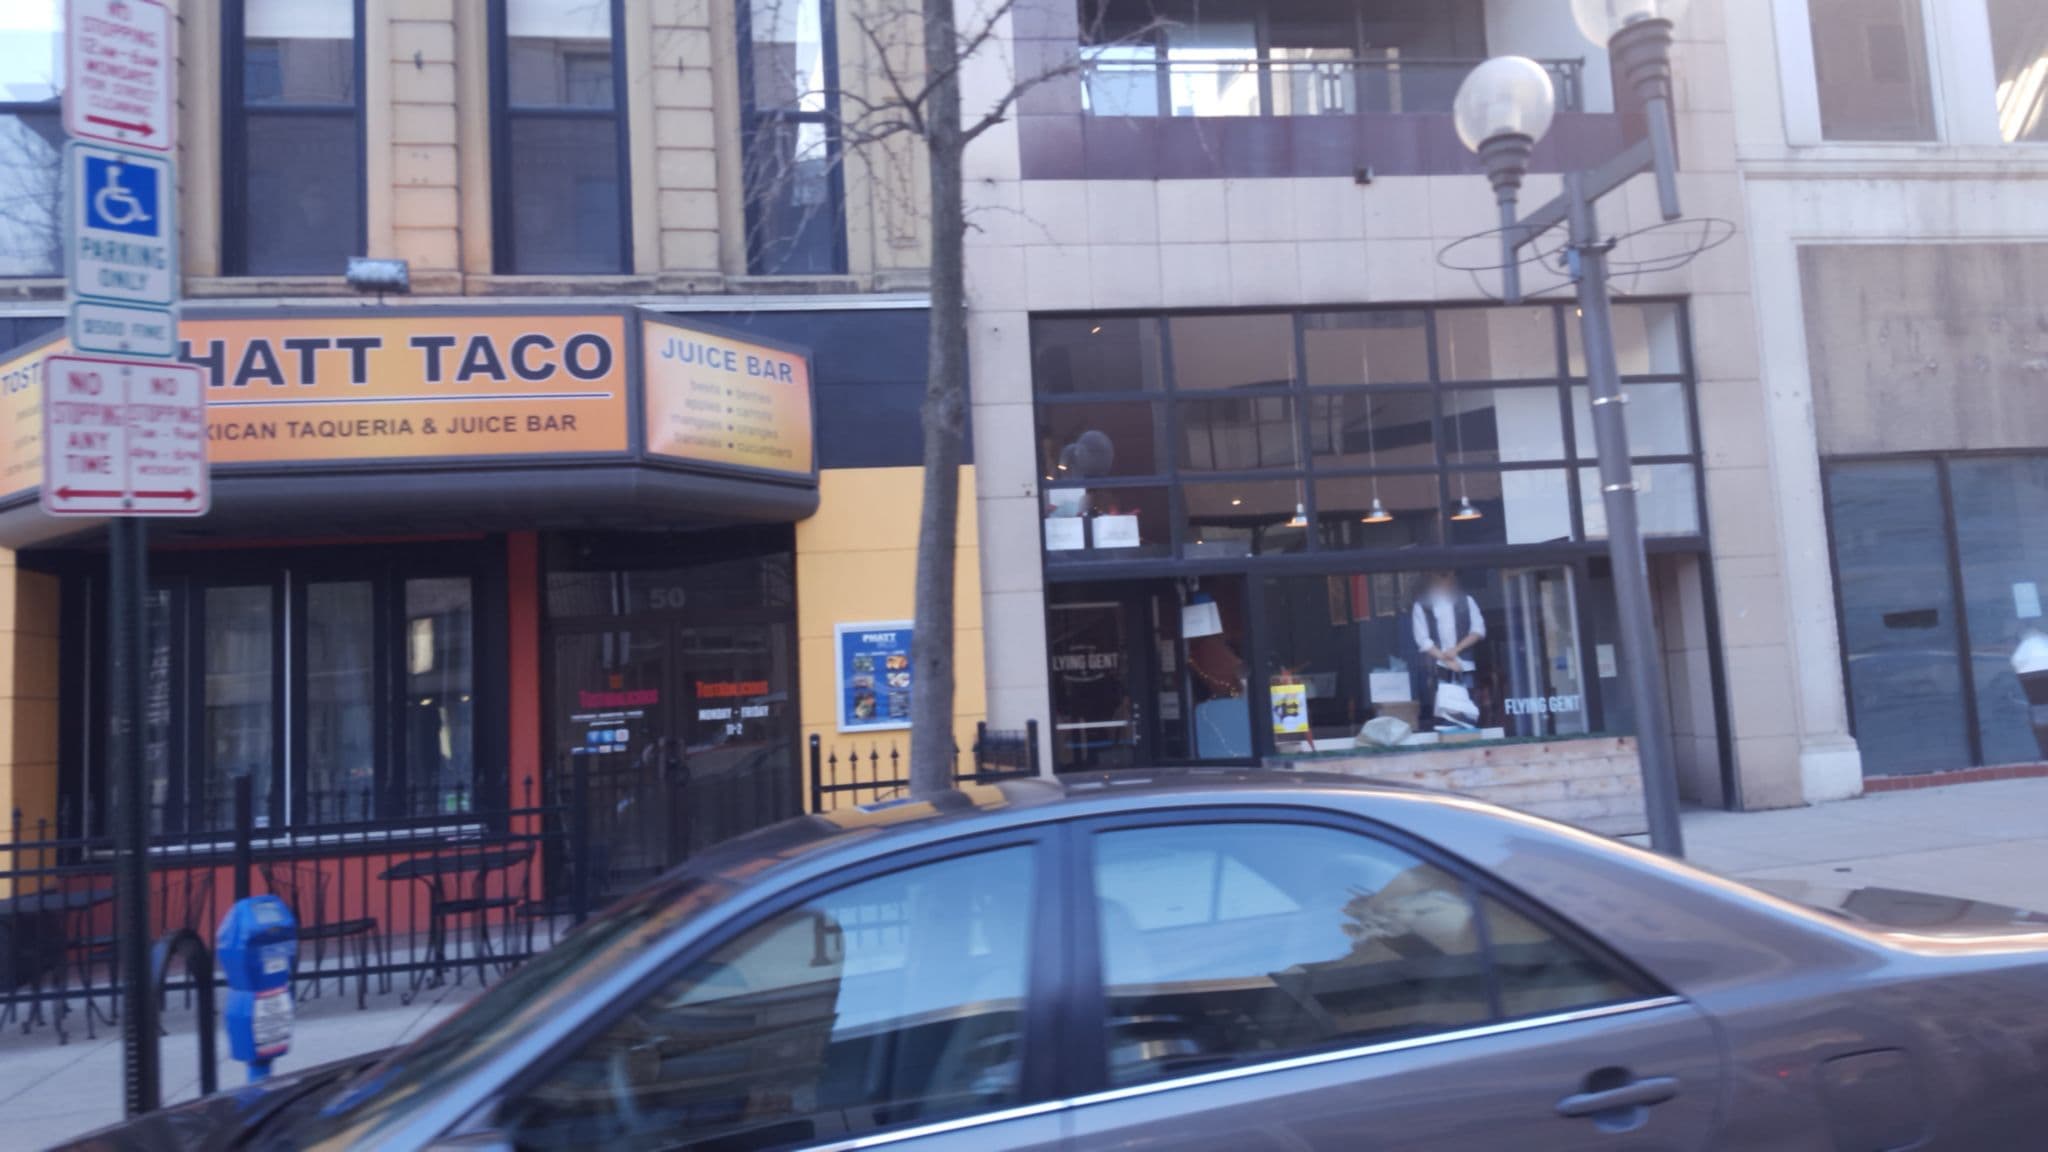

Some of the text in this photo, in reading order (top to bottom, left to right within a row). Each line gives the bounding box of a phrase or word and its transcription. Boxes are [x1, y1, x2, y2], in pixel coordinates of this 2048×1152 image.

[81, 237, 165, 270] PARKING
[98, 268, 148, 291] ONLY
[177, 333, 614, 387] HATT TACO
[662, 337, 794, 384] JUICE BAR
[2, 362, 42, 396] TOST
[67, 371, 103, 396] NO
[151, 377, 177, 397] NO
[206, 414, 578, 441] XICAN TAQUERIA & JUICE BAR
[66, 431, 110, 449] ANY
[65, 454, 112, 475] TIME
[650, 587, 686, 609] 50
[1052, 652, 1119, 671] LYING GENT
[1504, 695, 1580, 715] FLYING GENT
